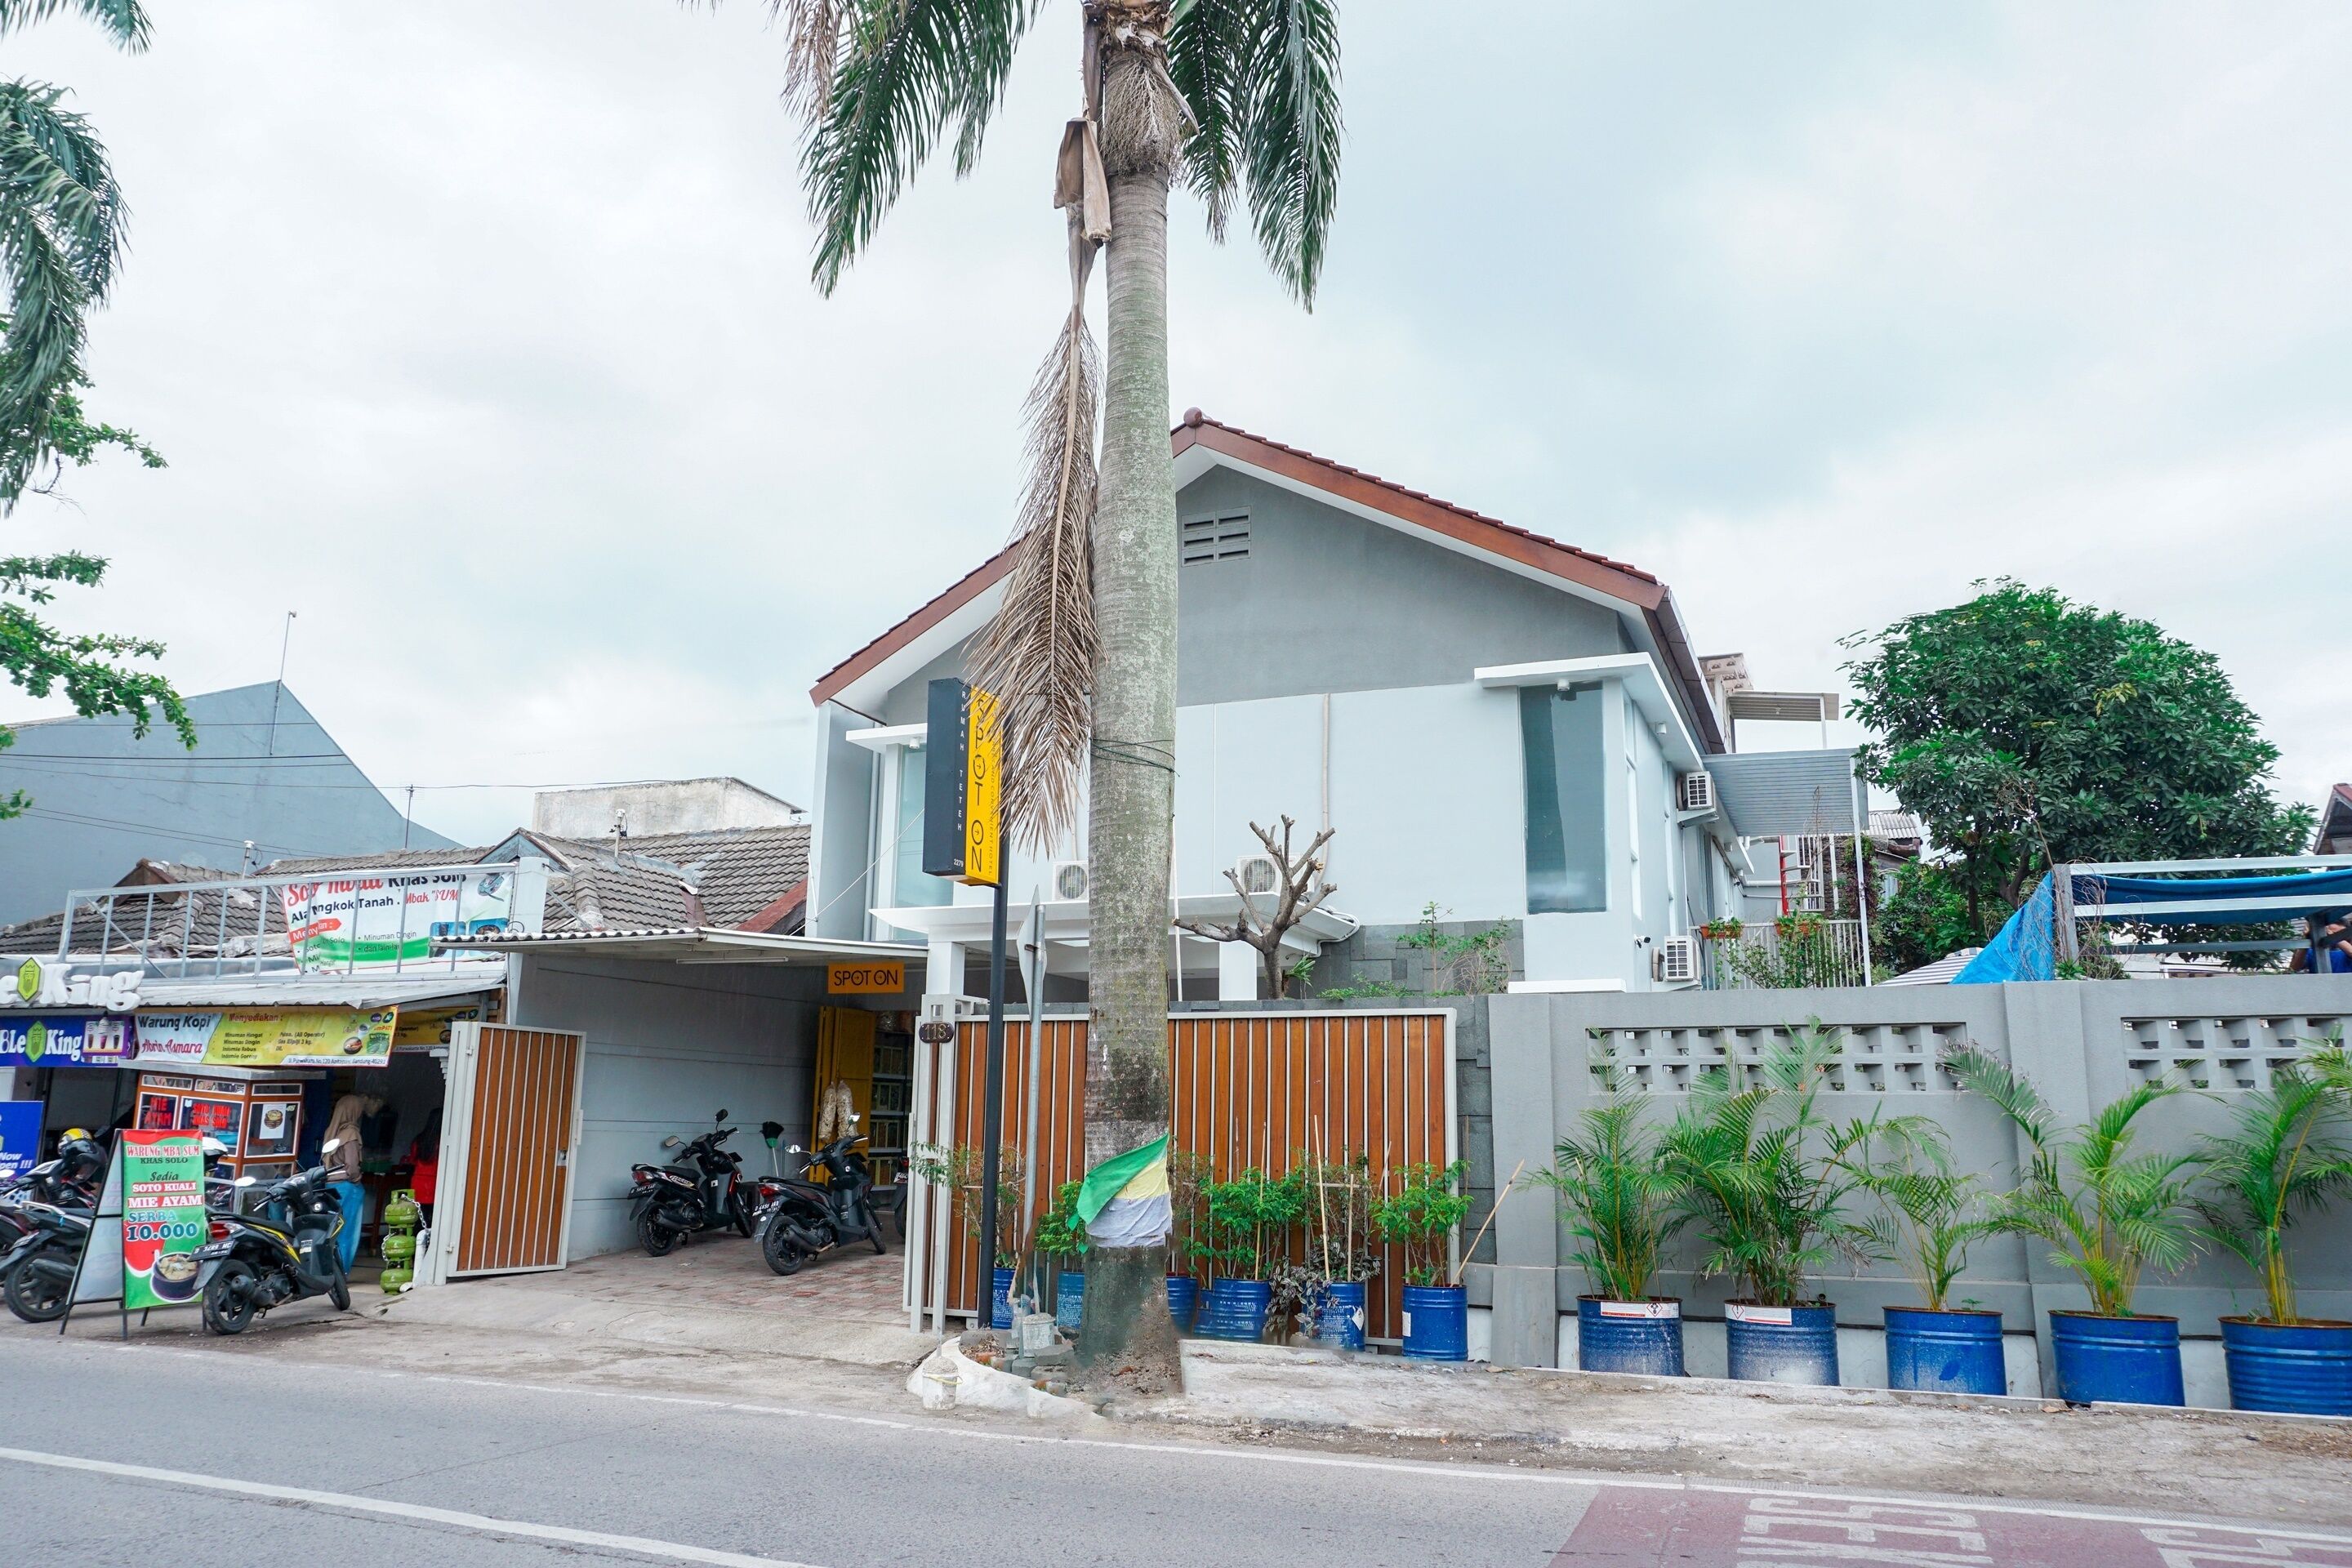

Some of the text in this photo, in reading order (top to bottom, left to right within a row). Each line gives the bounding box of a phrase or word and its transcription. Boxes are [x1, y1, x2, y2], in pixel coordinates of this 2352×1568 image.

[971, 819, 984, 873] ON
[359, 896, 394, 909] Tanah
[396, 931, 416, 939] Dngin
[834, 969, 898, 986] SPOT ON
[39, 963, 145, 1011] King
[138, 1015, 180, 1031] Warung
[183, 1015, 212, 1031] Kopi
[924, 1024, 947, 1040] 118
[45, 1029, 82, 1062] King
[166, 1038, 203, 1054] Asmara
[127, 1145, 200, 1156] WARUNG MBA SUM
[149, 1171, 179, 1182] Sedia
[132, 1182, 197, 1192] SOTO KUALI
[128, 1195, 203, 1209] MIE AYAM
[128, 1210, 177, 1223] SERBA
[127, 1223, 198, 1241] 10.000
